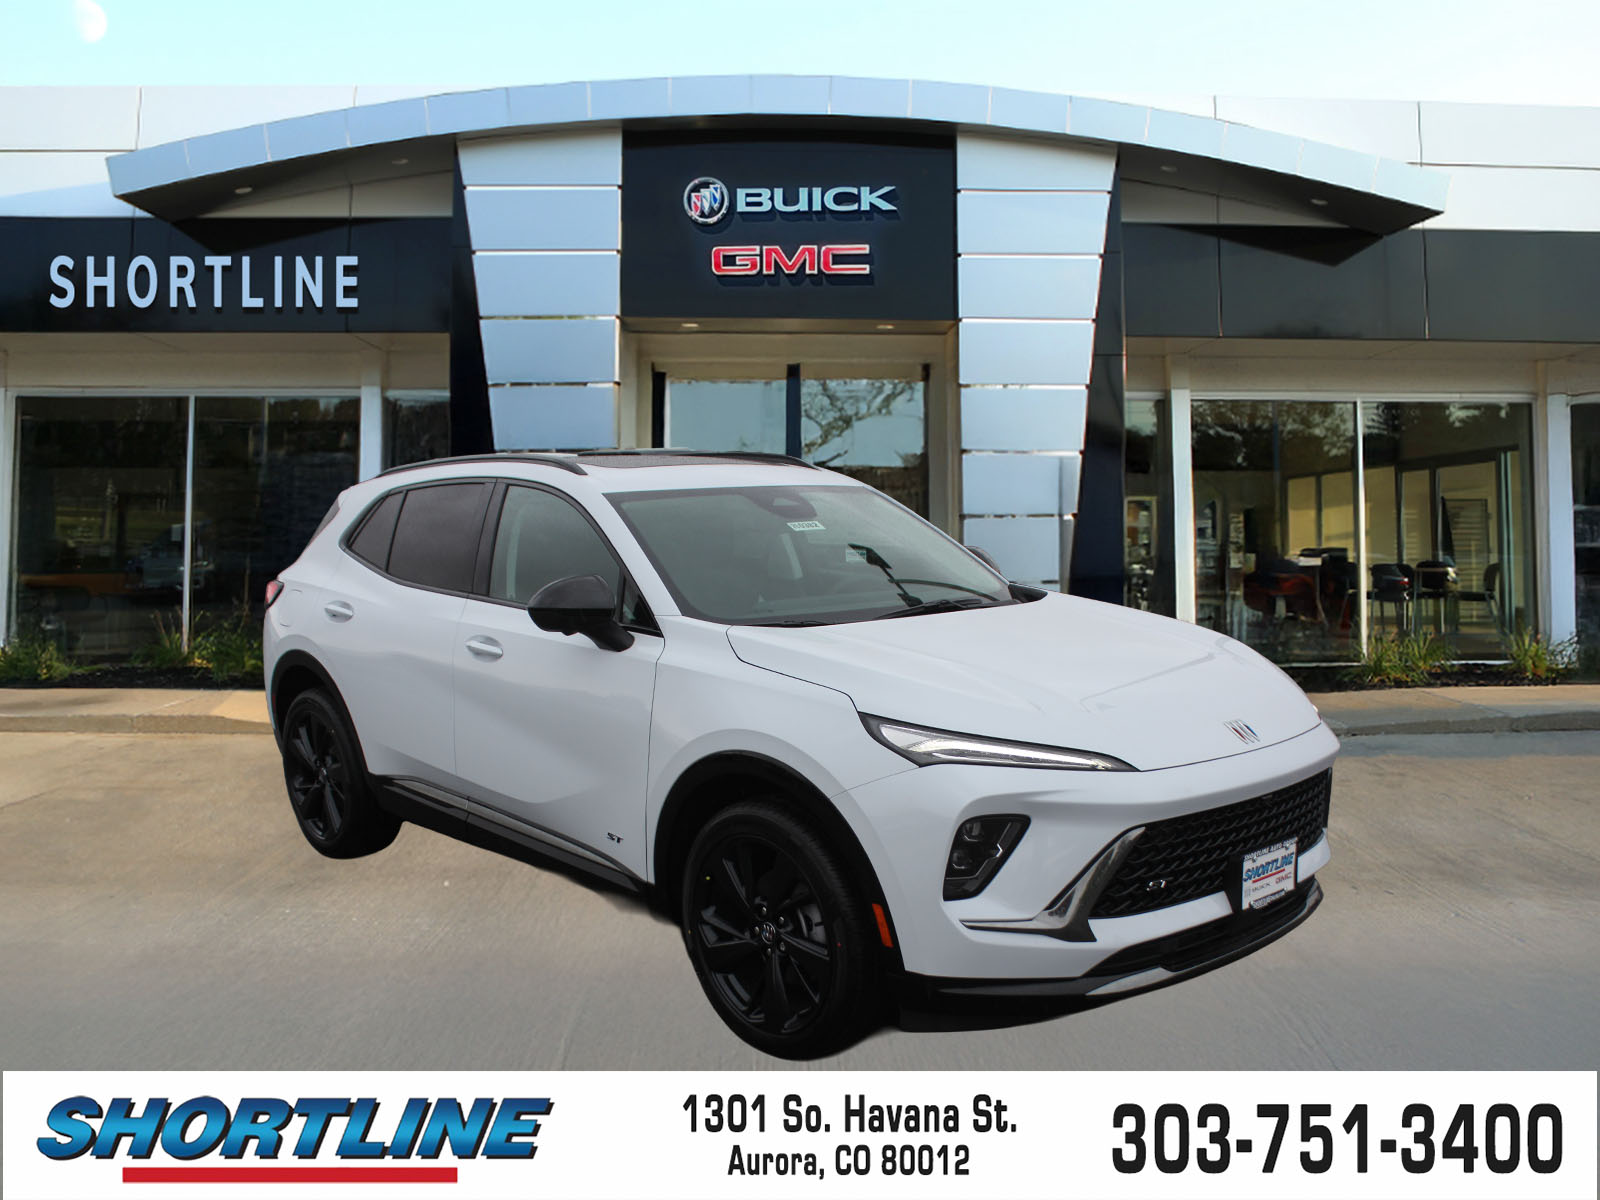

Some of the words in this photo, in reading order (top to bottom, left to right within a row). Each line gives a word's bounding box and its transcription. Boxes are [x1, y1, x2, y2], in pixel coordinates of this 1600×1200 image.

[736, 186, 898, 212] BUICK
[711, 244, 870, 276] GMC
[49, 255, 359, 308] SHORTLINE
[606, 832, 624, 843] ST
[1242, 852, 1295, 882] SHORTLINE
[1275, 871, 1292, 884] GMC
